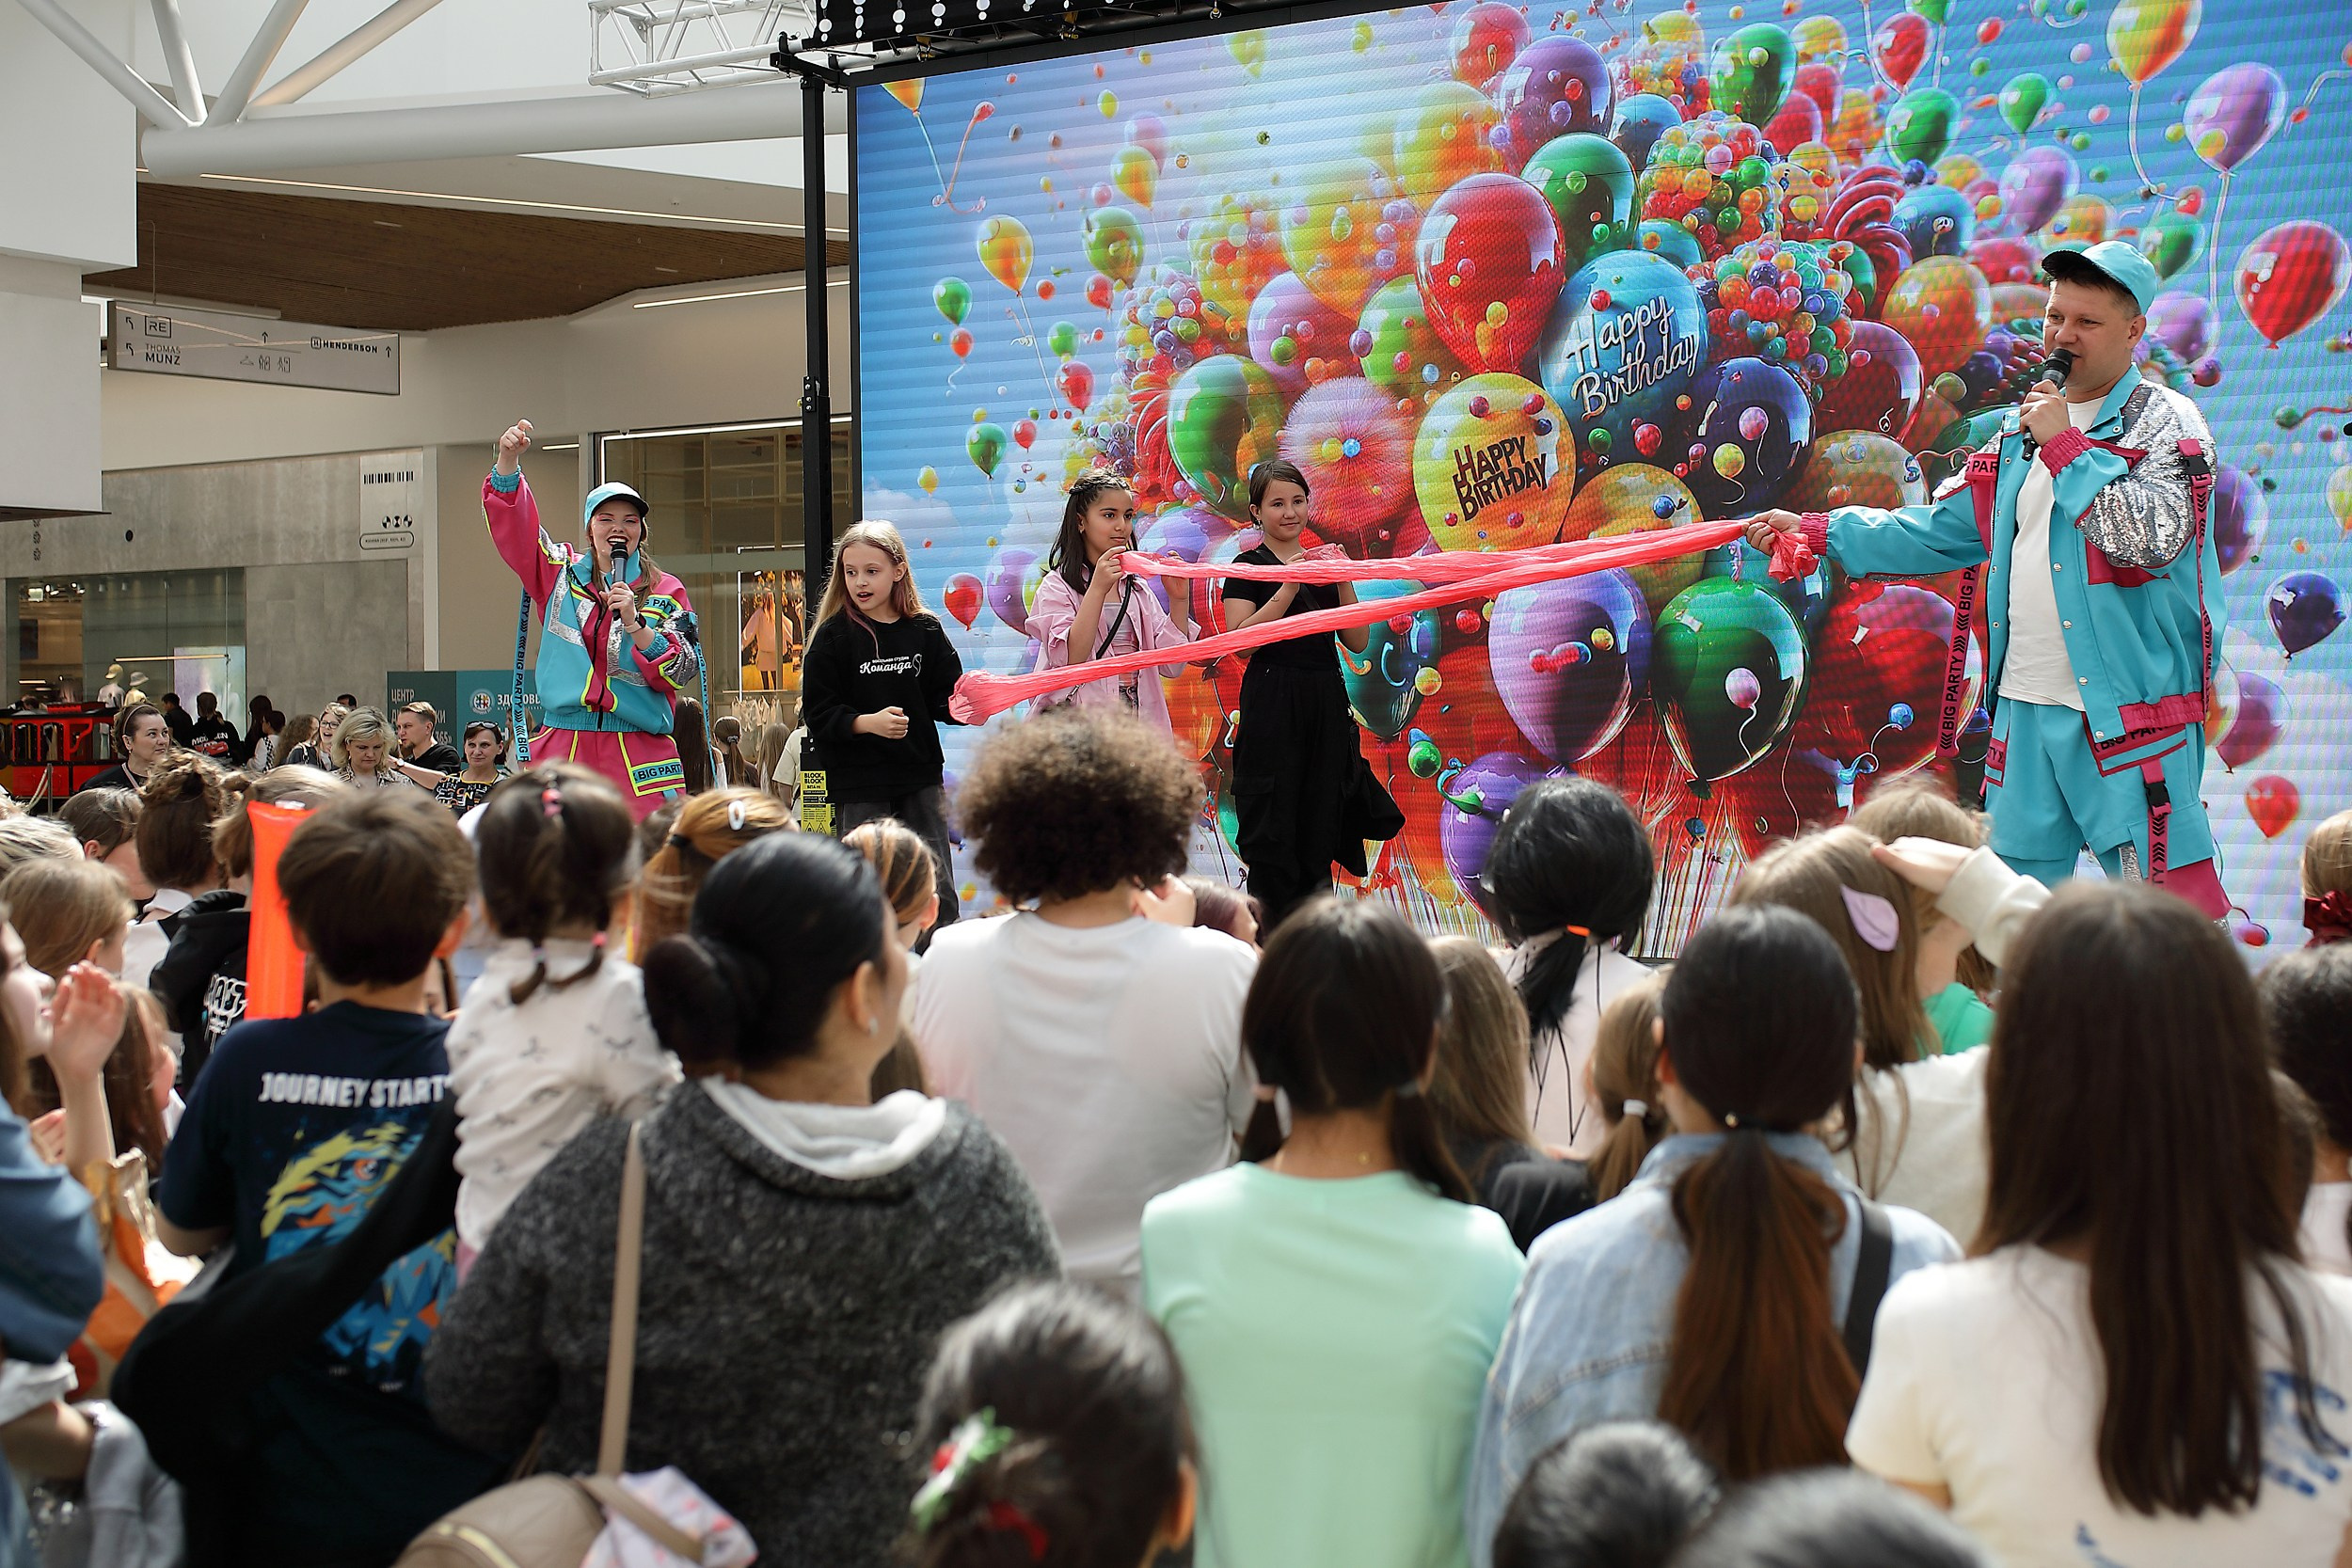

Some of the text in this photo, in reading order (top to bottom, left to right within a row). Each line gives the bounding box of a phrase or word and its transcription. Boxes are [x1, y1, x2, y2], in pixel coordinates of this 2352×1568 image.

[149, 321, 167, 333] RE
[1565, 295, 1675, 374] Happy
[145, 343, 182, 355] THOMAS
[323, 340, 378, 354] HENDERSON
[145, 352, 181, 366] MUNZ
[1570, 333, 1699, 421] Birthday
[1454, 436, 1526, 483] HAPPY
[1971, 460, 1998, 473] PAR
[1452, 452, 1549, 522] BIRTHDAY
[522, 594, 532, 618] RTY
[1958, 585, 1974, 611] BIG
[859, 661, 913, 674] Команда
[514, 651, 525, 708] BIG PARTY
[390, 689, 415, 705] ЦЕНТР
[1942, 656, 1963, 731] BIG PARTY
[516, 737, 529, 753] BIG
[638, 764, 682, 780] BIG PART
[258, 1071, 370, 1108] JOURNEY
